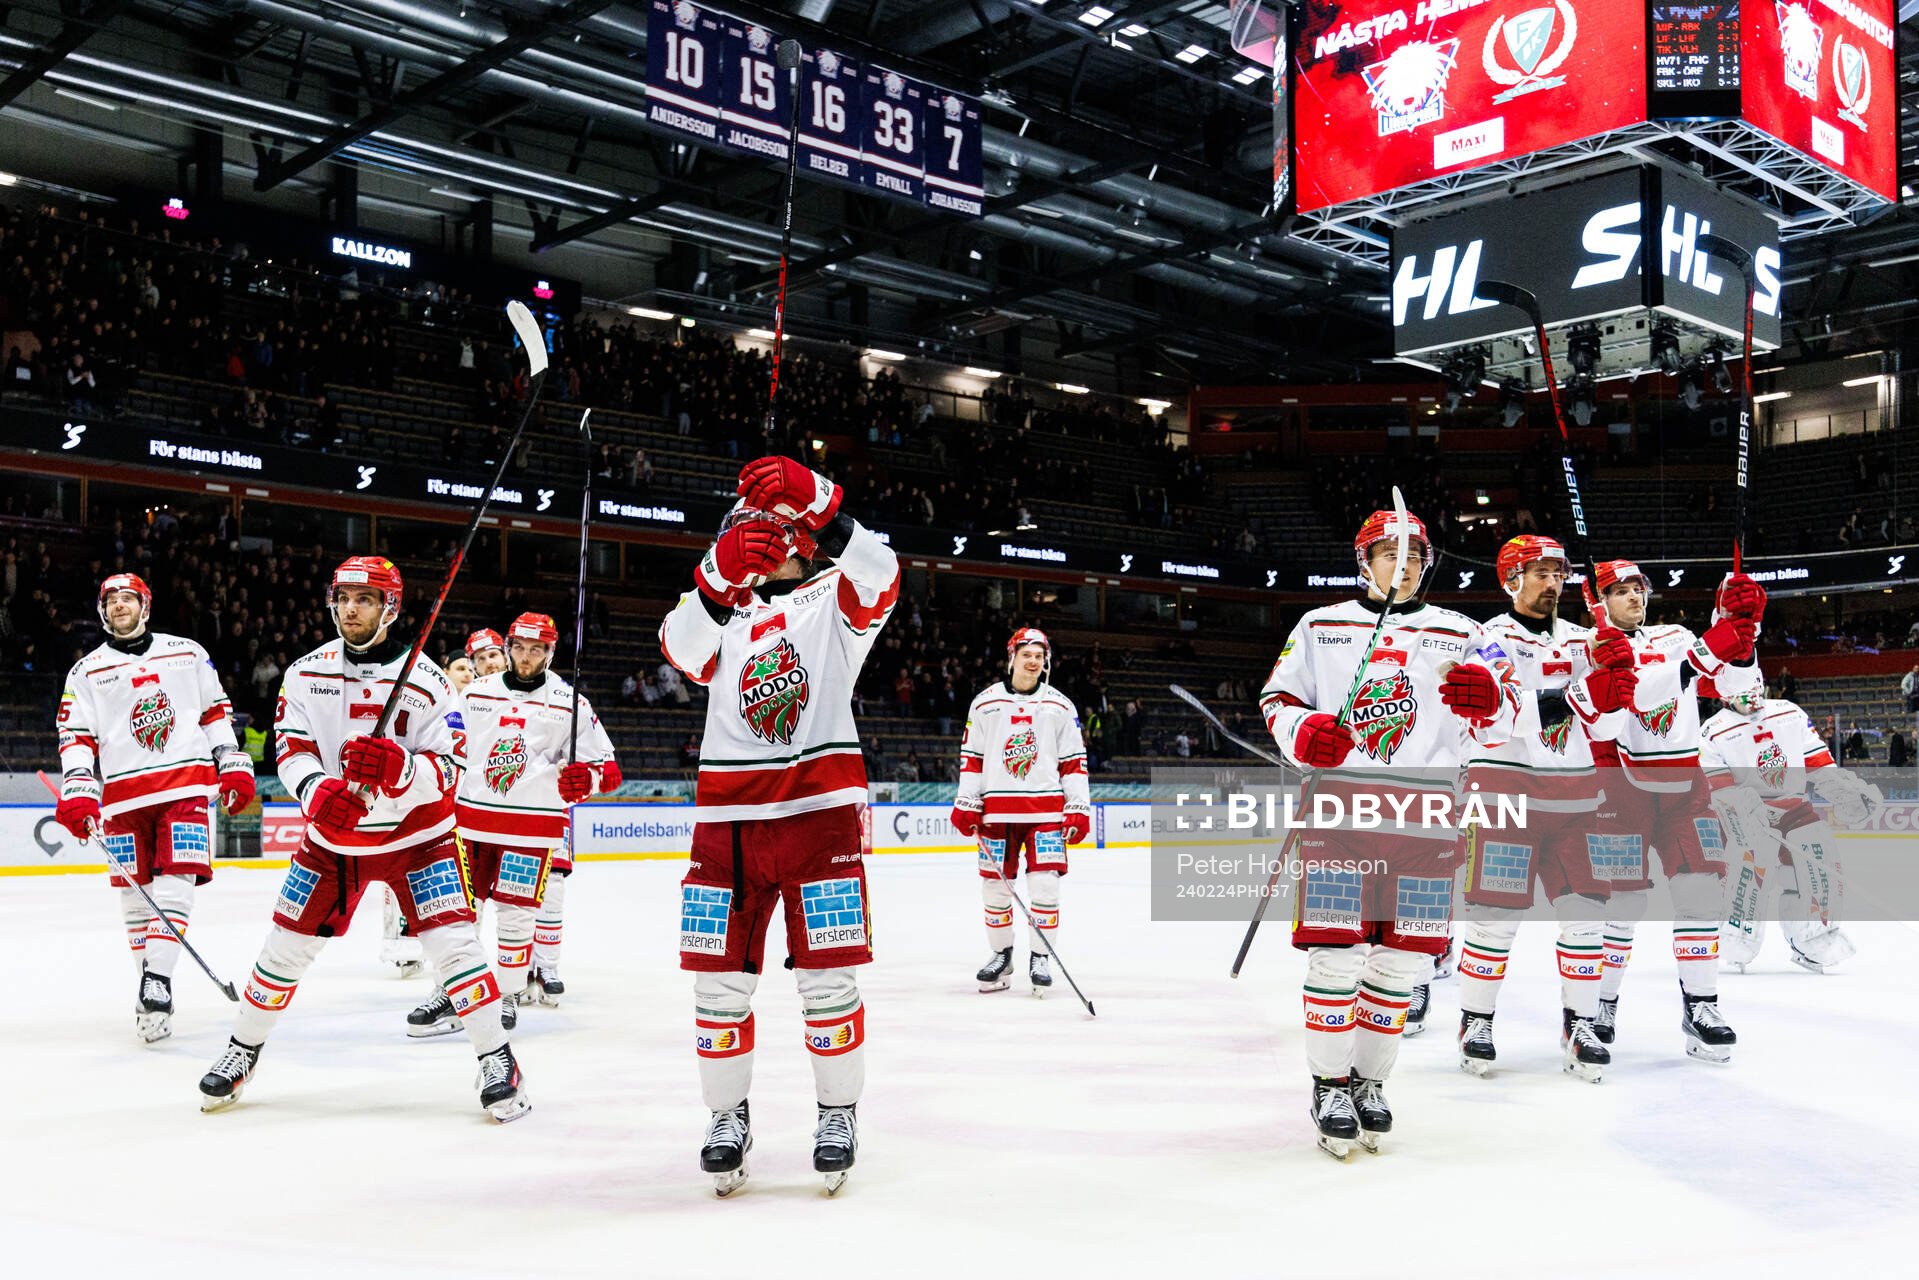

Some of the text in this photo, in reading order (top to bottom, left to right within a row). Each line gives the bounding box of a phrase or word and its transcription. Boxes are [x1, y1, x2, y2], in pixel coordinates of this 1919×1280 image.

[1656, 23, 1674, 31] MIF
[1681, 22, 1700, 31] RBK
[1656, 34, 1670, 43] LIF
[1656, 45, 1671, 54] TIK
[665, 31, 704, 89] 10
[1656, 56, 1680, 65] HV71
[1689, 55, 1709, 65] FHC
[740, 57, 776, 112] 15
[811, 81, 846, 133] 16
[650, 105, 716, 140] ANDERSSON
[874, 100, 914, 154] 33
[727, 129, 789, 159] JACOBSSON
[943, 126, 964, 171] 7
[809, 153, 849, 178] HELBER
[875, 172, 913, 196] EMVALL
[928, 191, 982, 217] JOHANSSON
[331, 236, 412, 269] KALLZON
[1570, 202, 1642, 289] S
[149, 440, 263, 470] För stans bästa
[1736, 410, 1750, 489] BAUER
[427, 479, 451, 495] För
[1562, 456, 1588, 537] BAUER
[600, 500, 685, 522] För stans bästa
[1001, 544, 1067, 562] För stans bästa
[1307, 575, 1327, 586] För
[1327, 576, 1356, 587] stans
[1777, 568, 1809, 580] bästa
[1317, 636, 1353, 645] TEMPUR
[1494, 661, 1521, 686] 2
[309, 687, 341, 697] TEMPUR
[742, 669, 804, 707] MODO
[751, 682, 803, 729] HOCKEY
[1352, 699, 1414, 723] MODO
[132, 708, 174, 730] MODO
[451, 731, 467, 759] 2
[1005, 744, 1037, 758] MODO
[487, 753, 525, 768] MODO
[1759, 755, 1785, 773] MODO
[592, 823, 693, 839] Handelsbank
[831, 852, 862, 865] BAUER
[1728, 867, 1754, 928] Byberg
[1675, 946, 1708, 956] OKQ8
[1462, 959, 1493, 976] OKQ8
[1306, 1010, 1345, 1026] OKQ8
[1355, 1006, 1392, 1027] OKQ8
